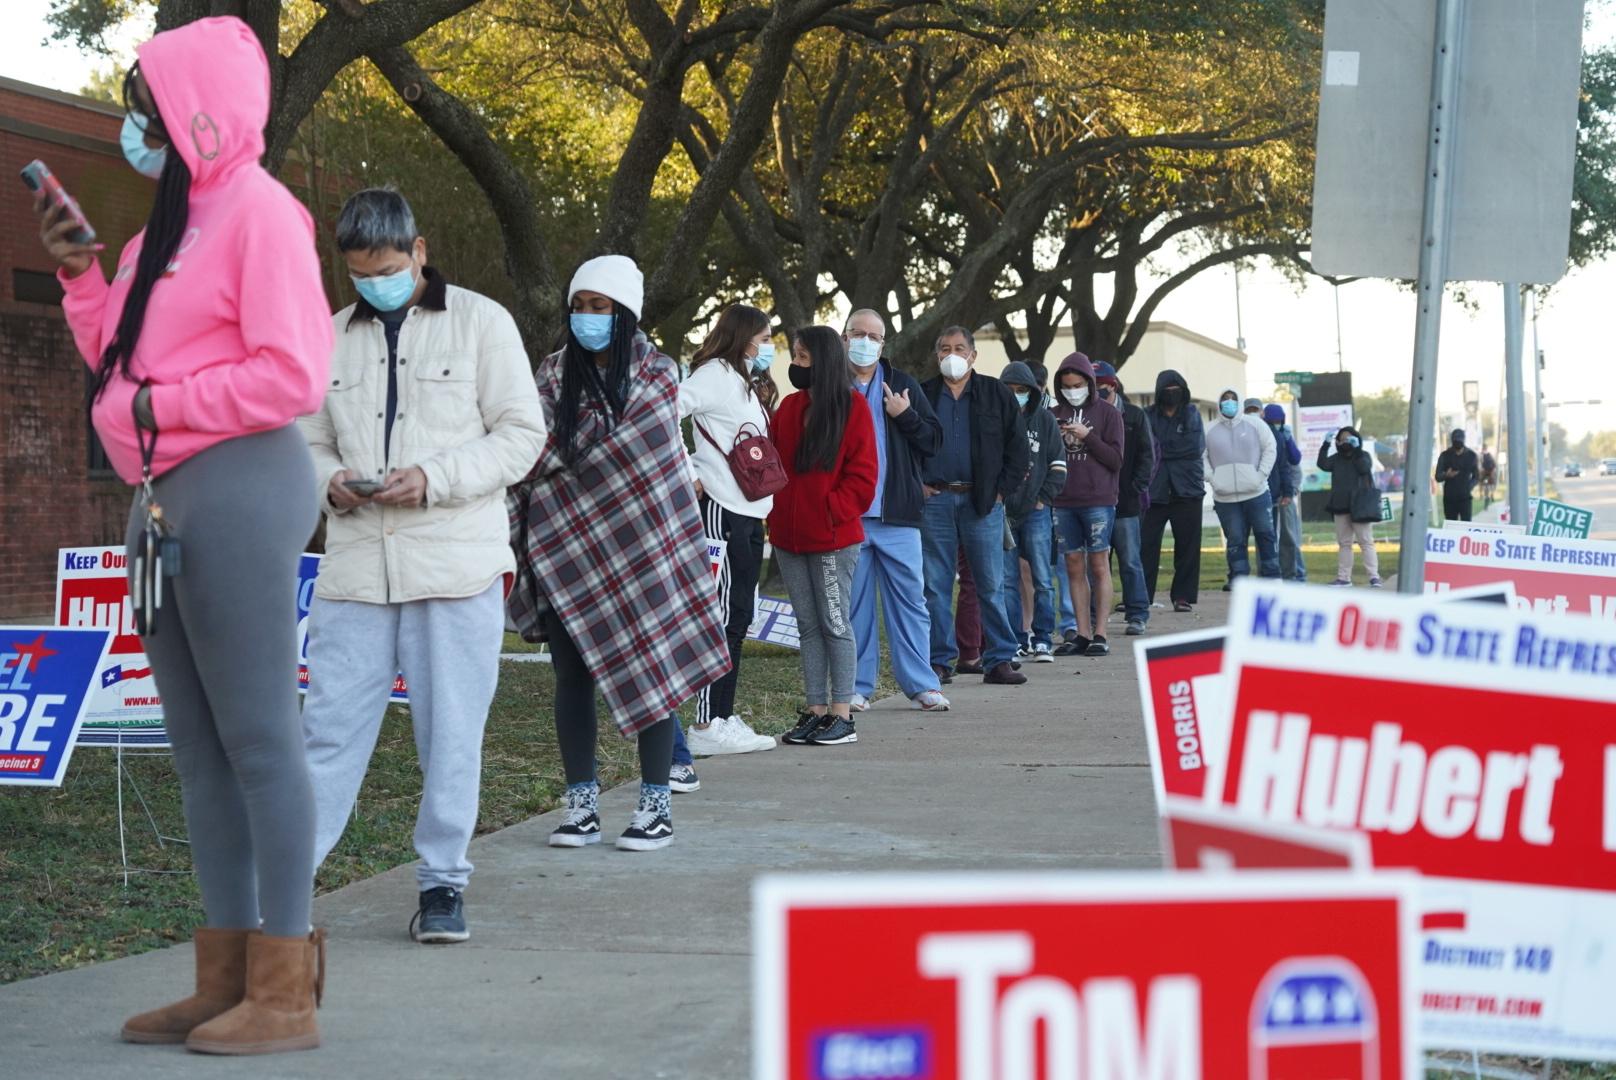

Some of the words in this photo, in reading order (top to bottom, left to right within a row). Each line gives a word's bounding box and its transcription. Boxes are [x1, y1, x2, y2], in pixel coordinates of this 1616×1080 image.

[1542, 502, 1588, 529] VOTE
[65, 552, 98, 570] KEEP
[1459, 536, 1490, 557] OUR
[1494, 538, 1537, 561] STATE
[1541, 543, 1616, 567] REPRESENT
[822, 555, 846, 636] FLAWLESS
[1252, 596, 1325, 643] KEEP
[1337, 604, 1401, 651] OUR
[1415, 614, 1500, 663] STATE
[1168, 679, 1202, 772] BORRIS
[31, 758, 41, 769] 3
[1238, 709, 1564, 846] Hubert
[1514, 946, 1554, 972] 149
